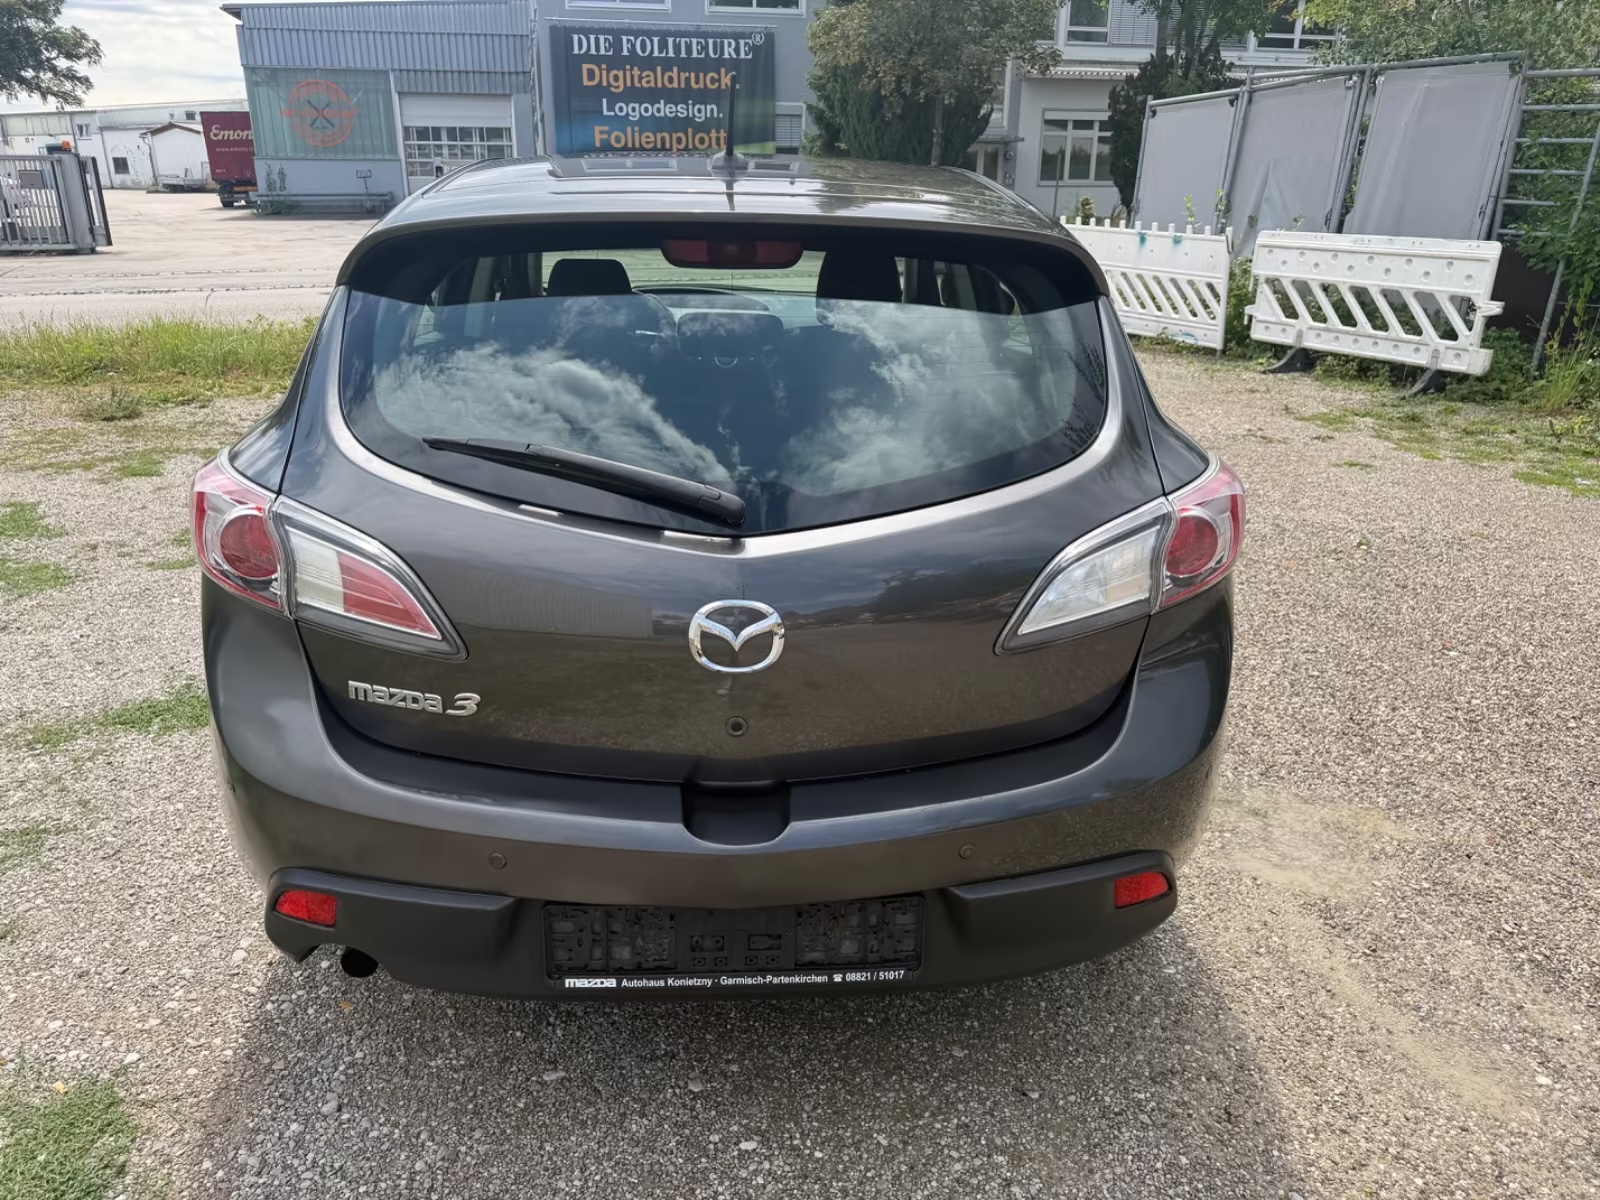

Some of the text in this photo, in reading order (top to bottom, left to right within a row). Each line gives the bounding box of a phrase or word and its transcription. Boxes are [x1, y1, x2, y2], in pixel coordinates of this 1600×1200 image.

[571, 34, 614, 56] DIE
[581, 63, 741, 93] Digitaldruck.
[602, 98, 724, 122] Logodesign.
[348, 680, 481, 717] mazda 3
[565, 978, 617, 988] mazda
[621, 978, 666, 988] Autohaus
[667, 976, 713, 988] Konietzny
[720, 974, 828, 985] Garmisch-Partenkirchen
[845, 972, 872, 982] 08821
[878, 970, 905, 980] 51017
